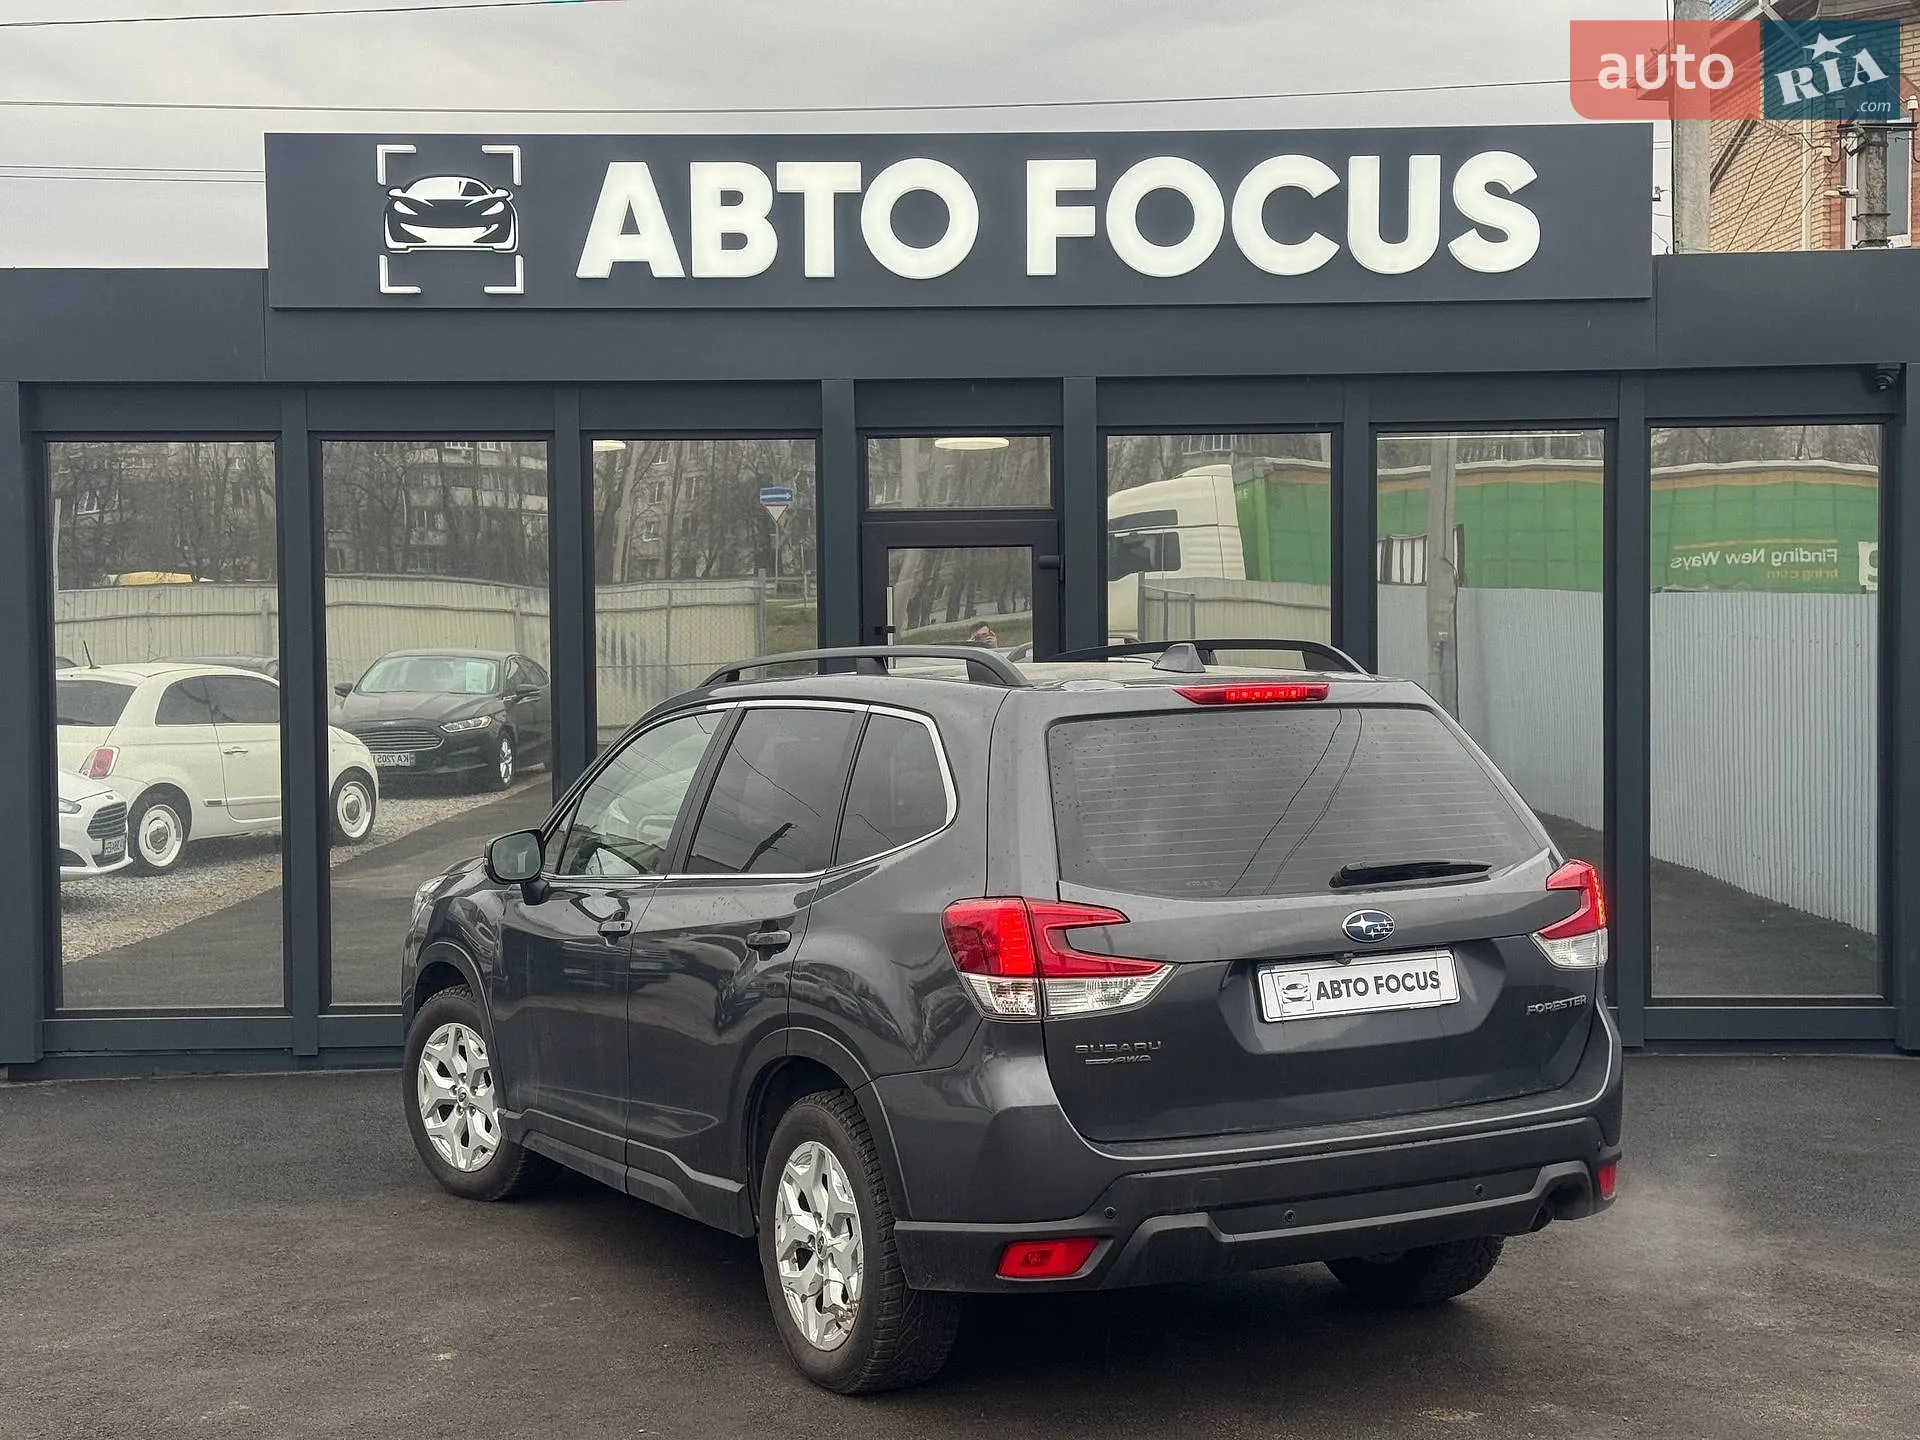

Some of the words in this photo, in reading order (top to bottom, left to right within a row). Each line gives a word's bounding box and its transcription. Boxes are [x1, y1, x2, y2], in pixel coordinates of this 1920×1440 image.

[575, 157, 981, 280] АВТО
[1025, 151, 1541, 277] FOCUS
[1316, 976, 1370, 1001] АВТО
[1373, 970, 1442, 995] FOCUS
[1526, 994, 1588, 1016] FORESTER
[1073, 1040, 1163, 1054] SUBARU
